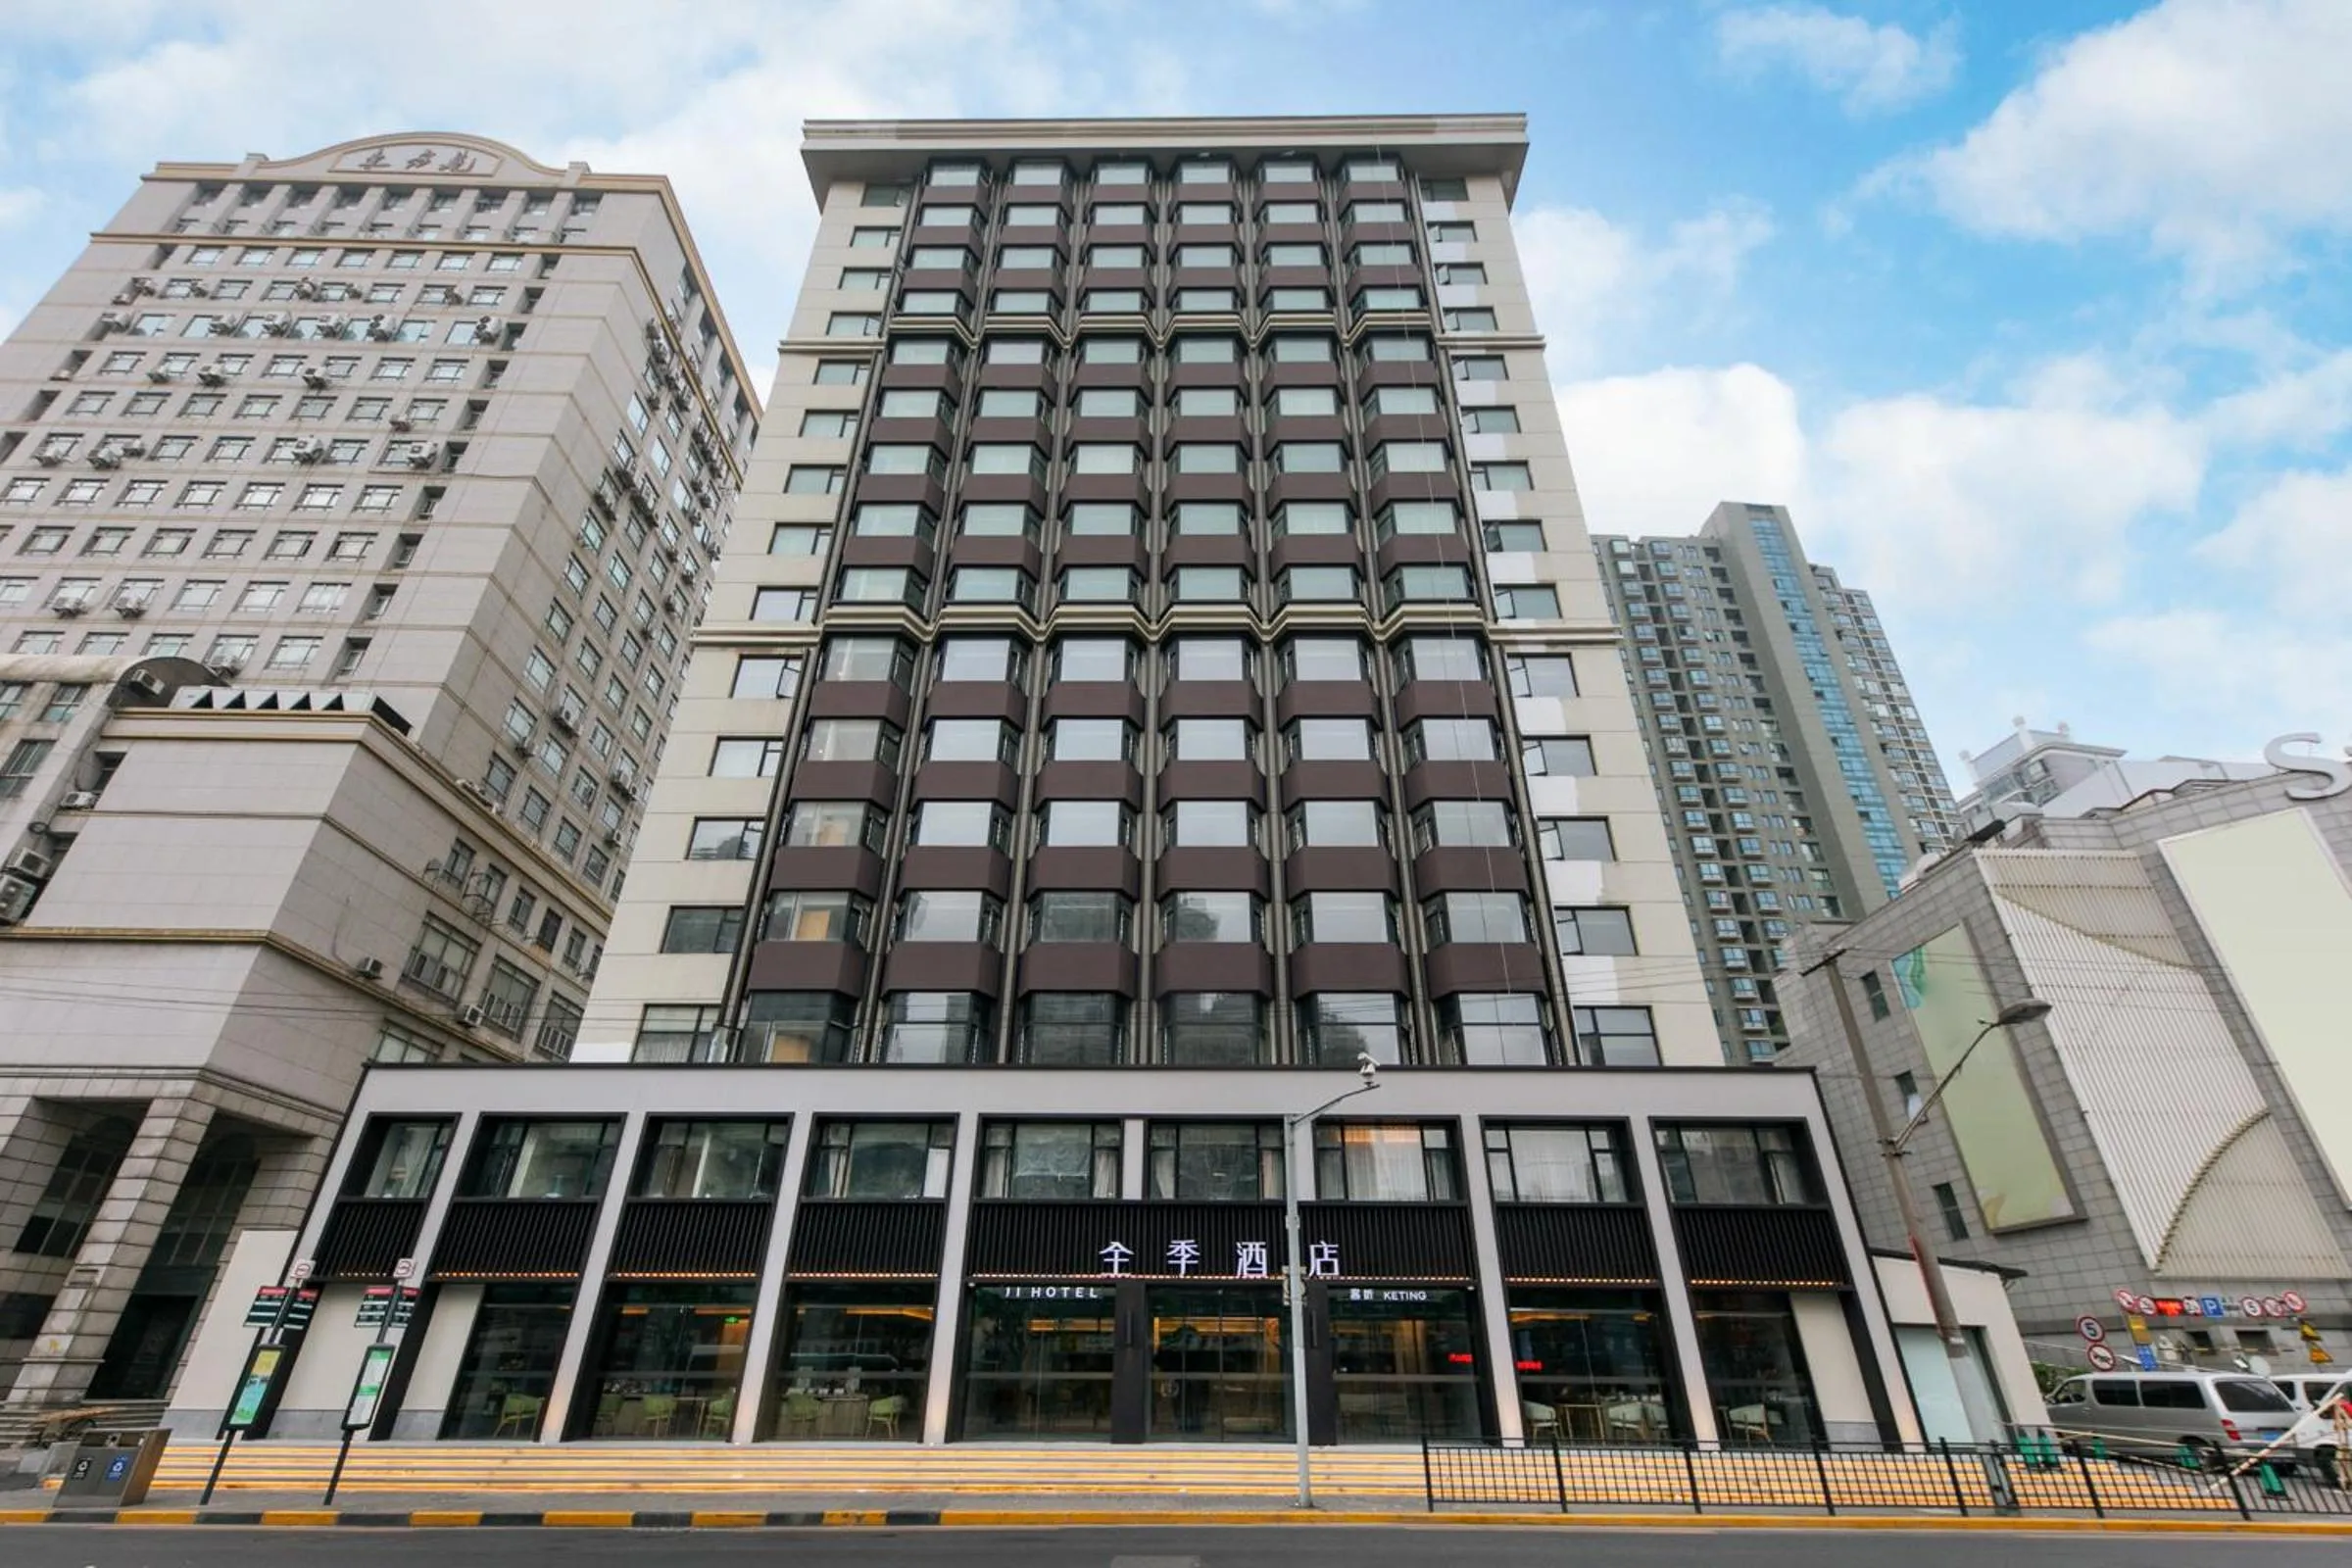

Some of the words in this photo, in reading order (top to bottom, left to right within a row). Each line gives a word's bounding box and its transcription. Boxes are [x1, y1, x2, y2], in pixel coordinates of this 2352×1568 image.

[1099, 1239, 1340, 1278] 全季酒店
[1004, 1286, 1020, 1298] JI
[1031, 1286, 1099, 1298] HOTEL
[1384, 1290, 1427, 1301] KETING
[2083, 1321, 2097, 1337] 5
